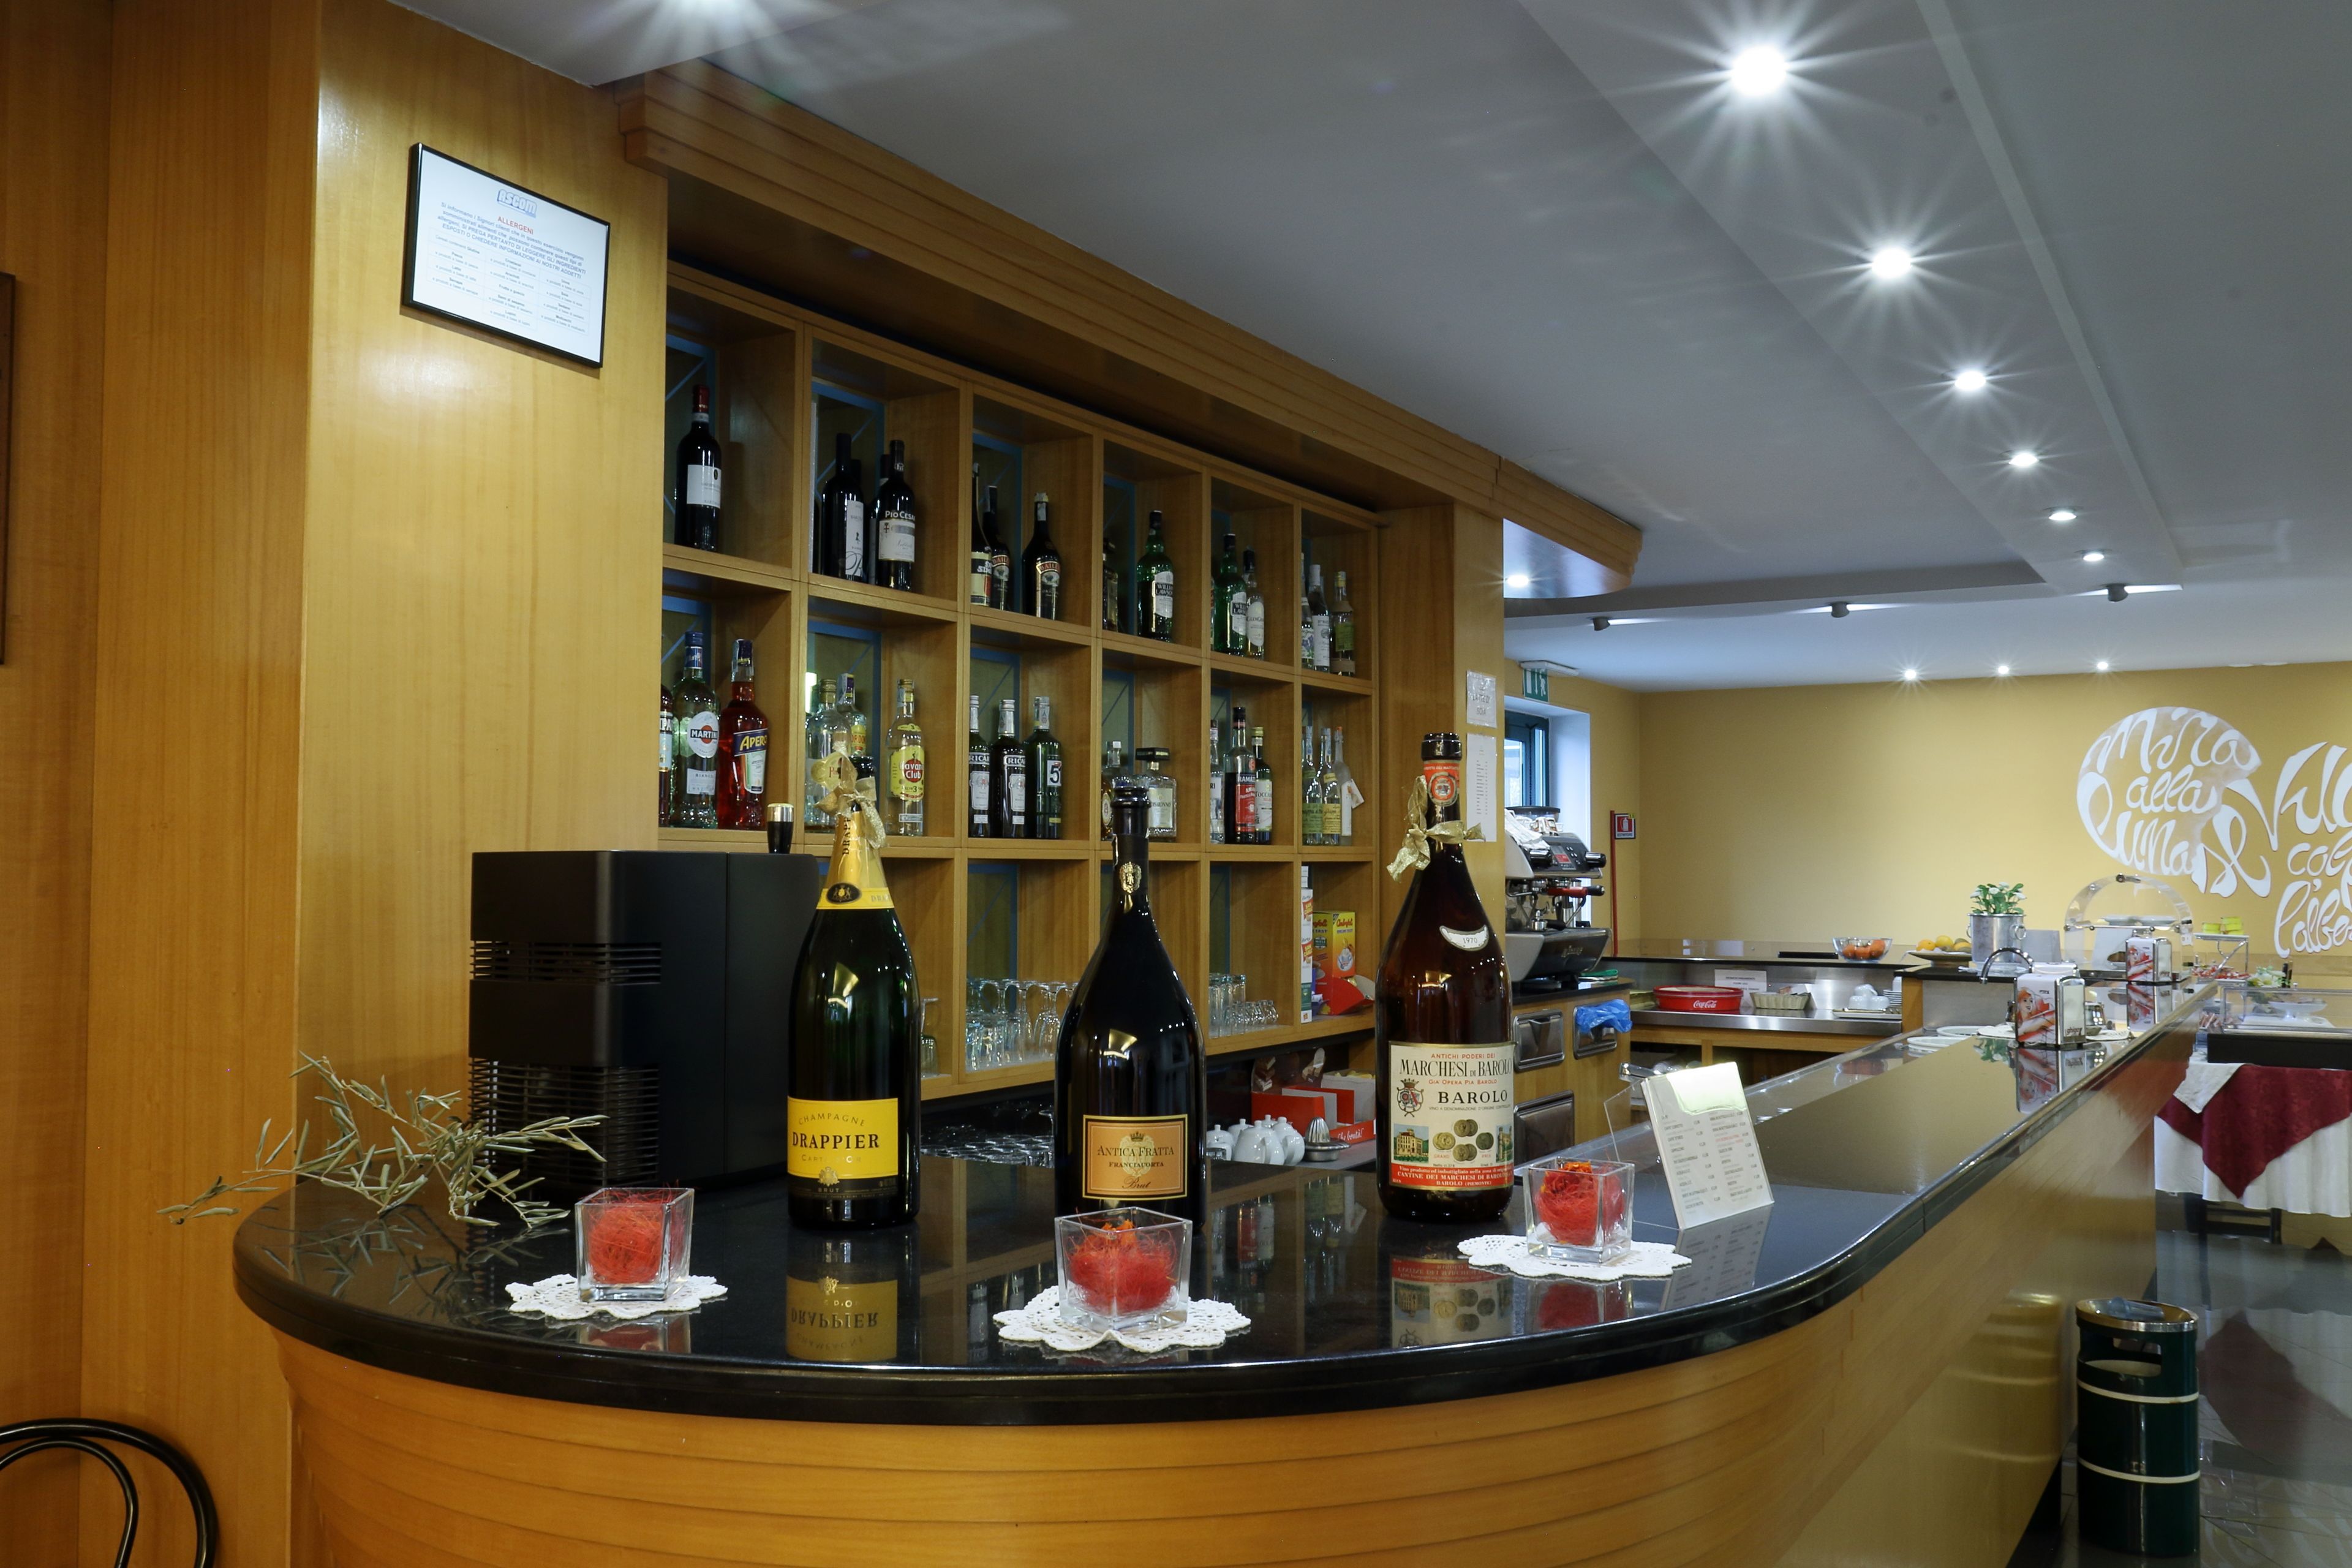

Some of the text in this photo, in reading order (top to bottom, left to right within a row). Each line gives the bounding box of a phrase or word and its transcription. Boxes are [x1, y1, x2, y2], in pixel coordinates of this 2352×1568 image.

[498, 187, 537, 216] ASCOM
[497, 215, 533, 236] ALLERGENI
[442, 222, 466, 236] ESPOSTI
[471, 233, 498, 248] CHIEDERE
[499, 244, 535, 262] INFORMAZIONI
[541, 260, 560, 271] NOSTRI
[560, 267, 581, 279] ADDETTI
[467, 225, 486, 238] PREGA
[486, 232, 514, 248] PERTANTO
[521, 246, 545, 260] LEGGERE
[546, 255, 555, 263] GLI
[555, 258, 586, 275] INGREDIENTI
[2082, 707, 2263, 774] Mira
[905, 771, 921, 779] Club
[2126, 764, 2222, 814] alla
[1400, 1059, 1468, 1077] MARCHESI
[1478, 1058, 1512, 1077] BAROLO
[1438, 1089, 1508, 1104] BAROLO
[798, 1112, 866, 1127] CHAMPAGNE
[793, 1131, 880, 1150] DRAPPIER
[1097, 1145, 1175, 1157] ANTICA FRATTA
[1121, 1176, 1152, 1189] Brut
[1397, 1171, 1424, 1180] CANTINE
